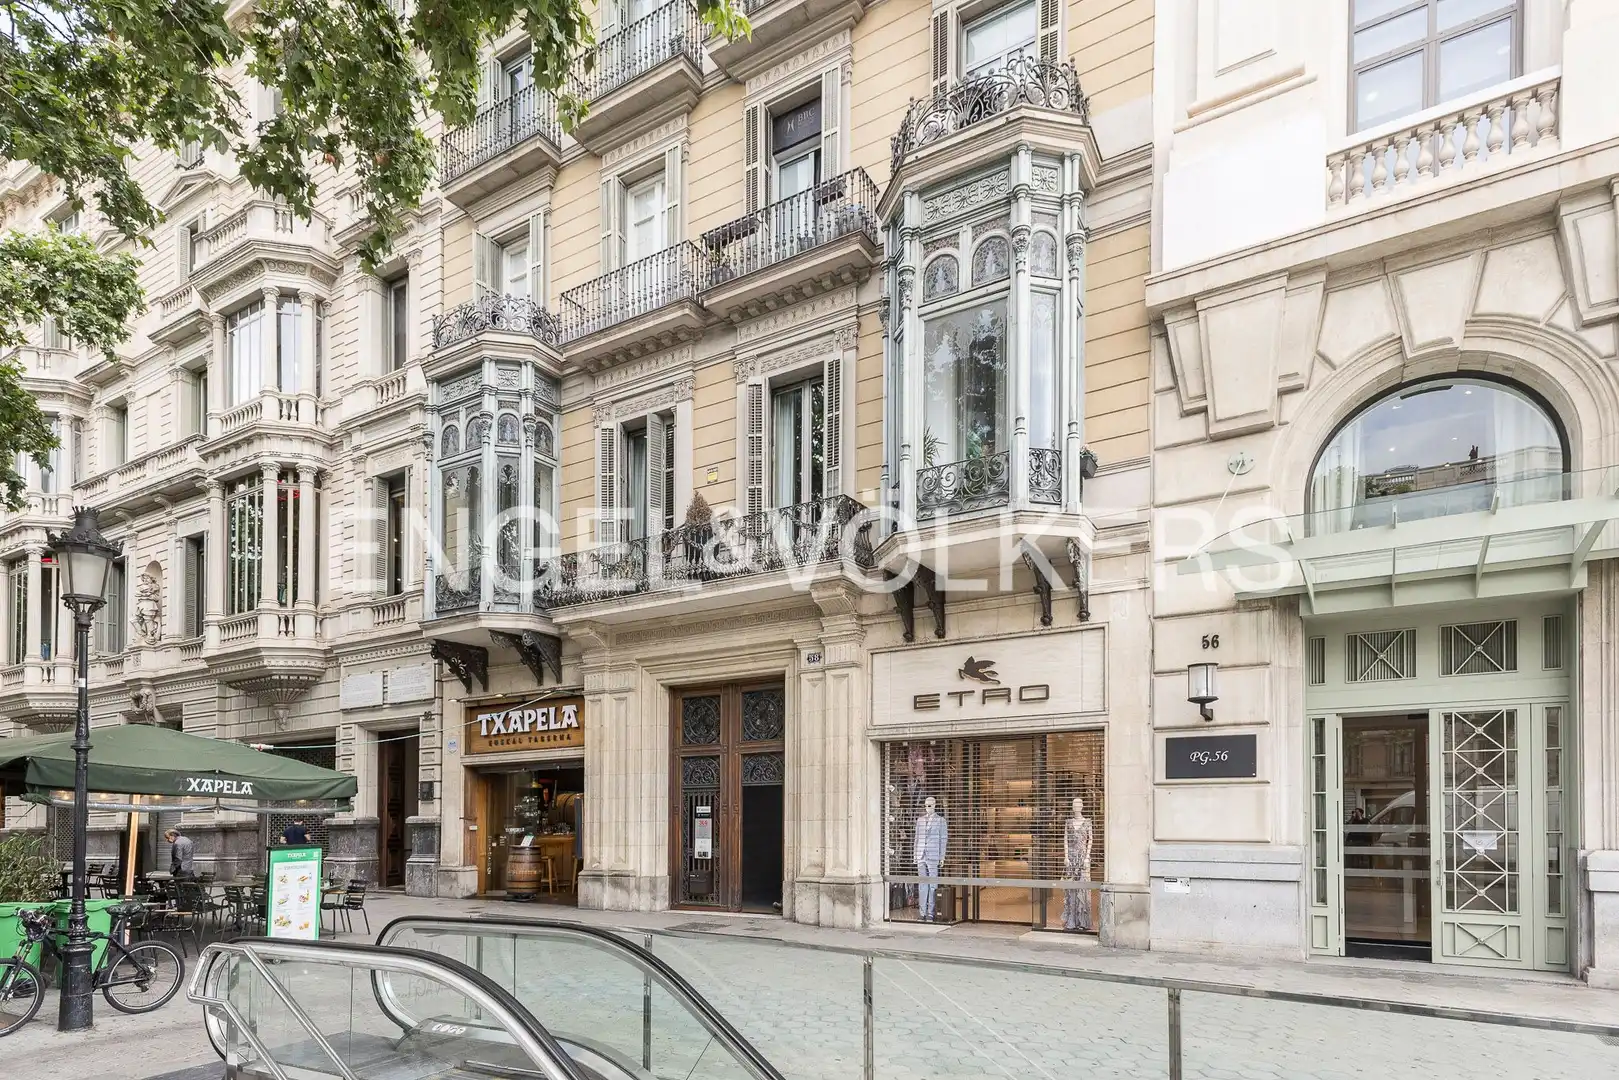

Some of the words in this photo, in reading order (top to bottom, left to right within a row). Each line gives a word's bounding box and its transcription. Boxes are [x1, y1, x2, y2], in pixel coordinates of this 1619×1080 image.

[1201, 634, 1220, 650] 56
[913, 684, 1050, 710] ETRO
[477, 704, 579, 736] TXAPELA
[1189, 750, 1229, 766] PG.56
[178, 777, 253, 796] XAPELA
